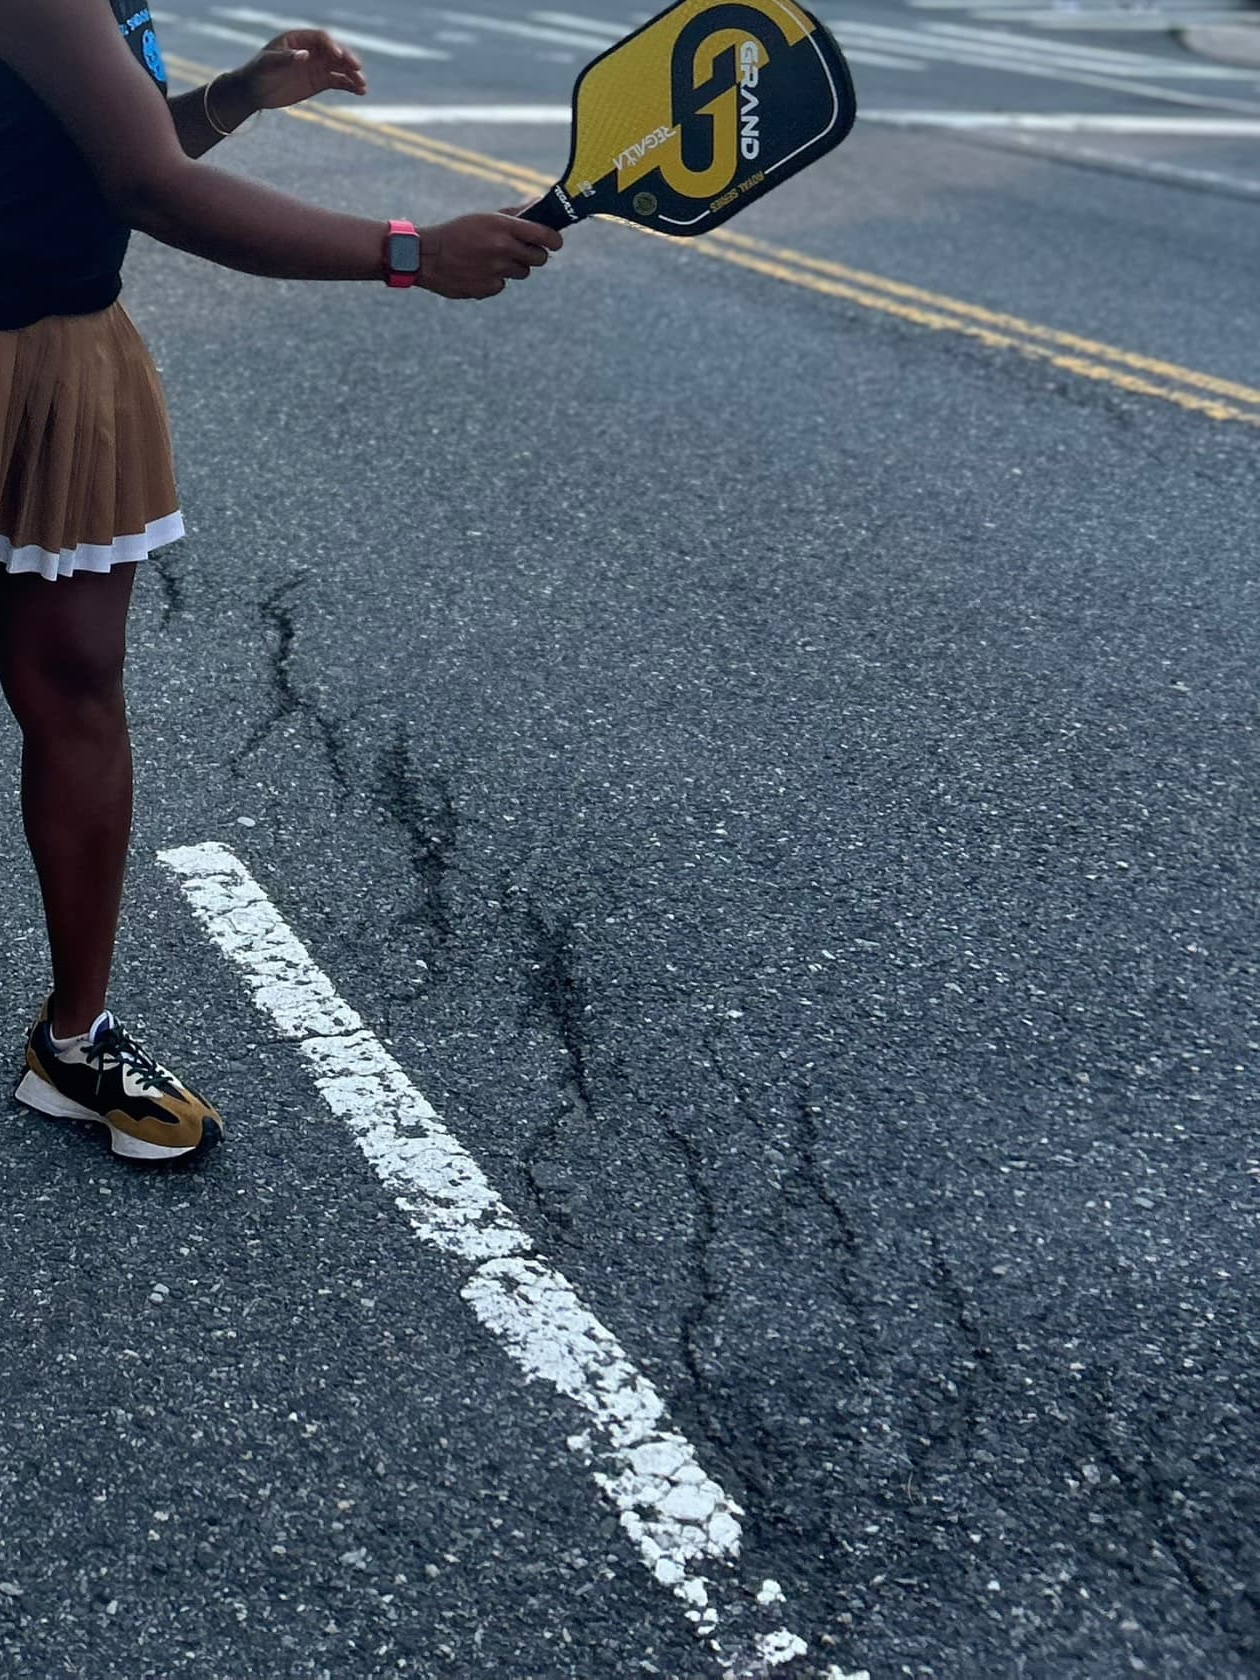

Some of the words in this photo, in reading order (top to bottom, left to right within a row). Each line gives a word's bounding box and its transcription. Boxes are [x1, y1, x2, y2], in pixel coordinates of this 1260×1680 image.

[740, 40, 760, 160] GRAND
[612, 125, 677, 171] REGALIA
[738, 171, 765, 193] ROYAL
[709, 188, 739, 213] SERIES
